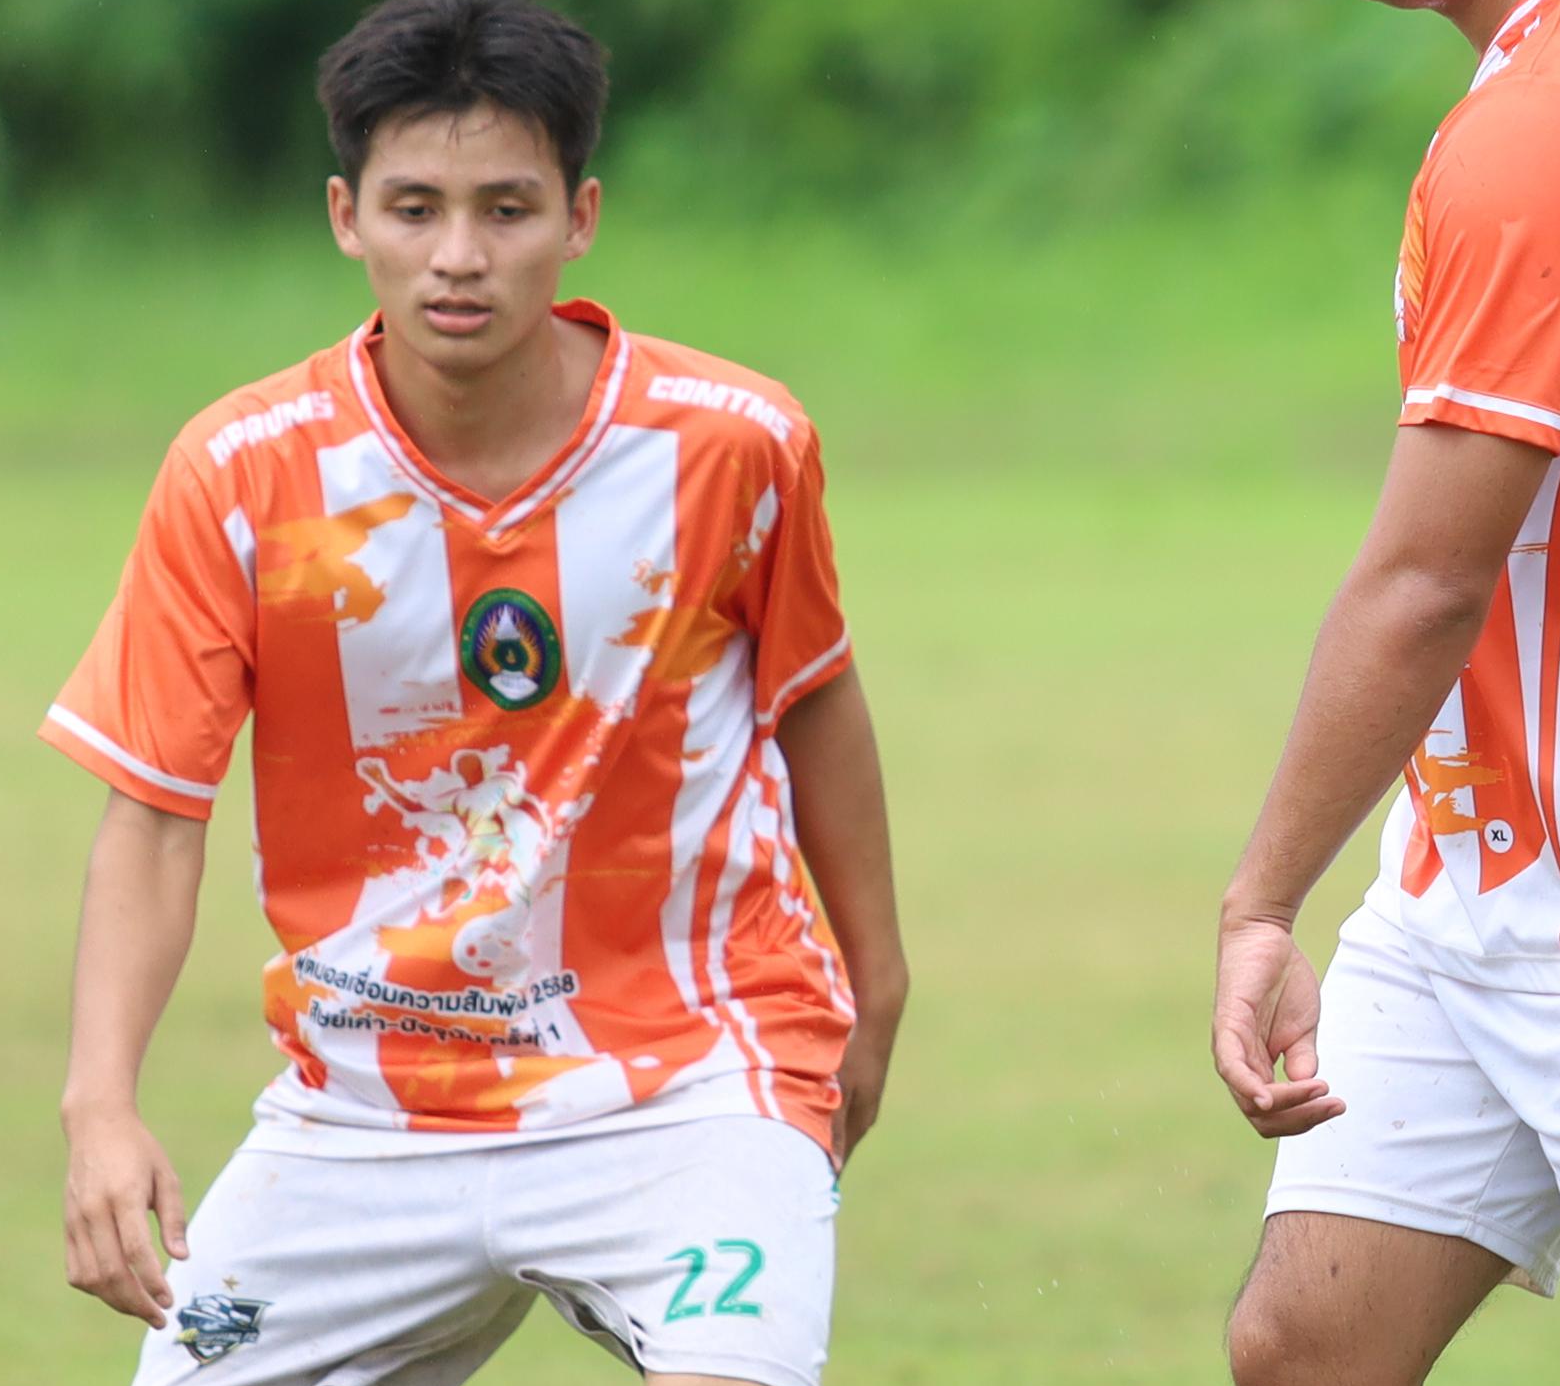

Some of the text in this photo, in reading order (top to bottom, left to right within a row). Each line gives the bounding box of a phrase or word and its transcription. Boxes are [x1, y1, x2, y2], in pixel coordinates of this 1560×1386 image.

[1490, 829, 1509, 842] XL
[547, 1023, 561, 1041] 1
[663, 1238, 766, 1324] 22
